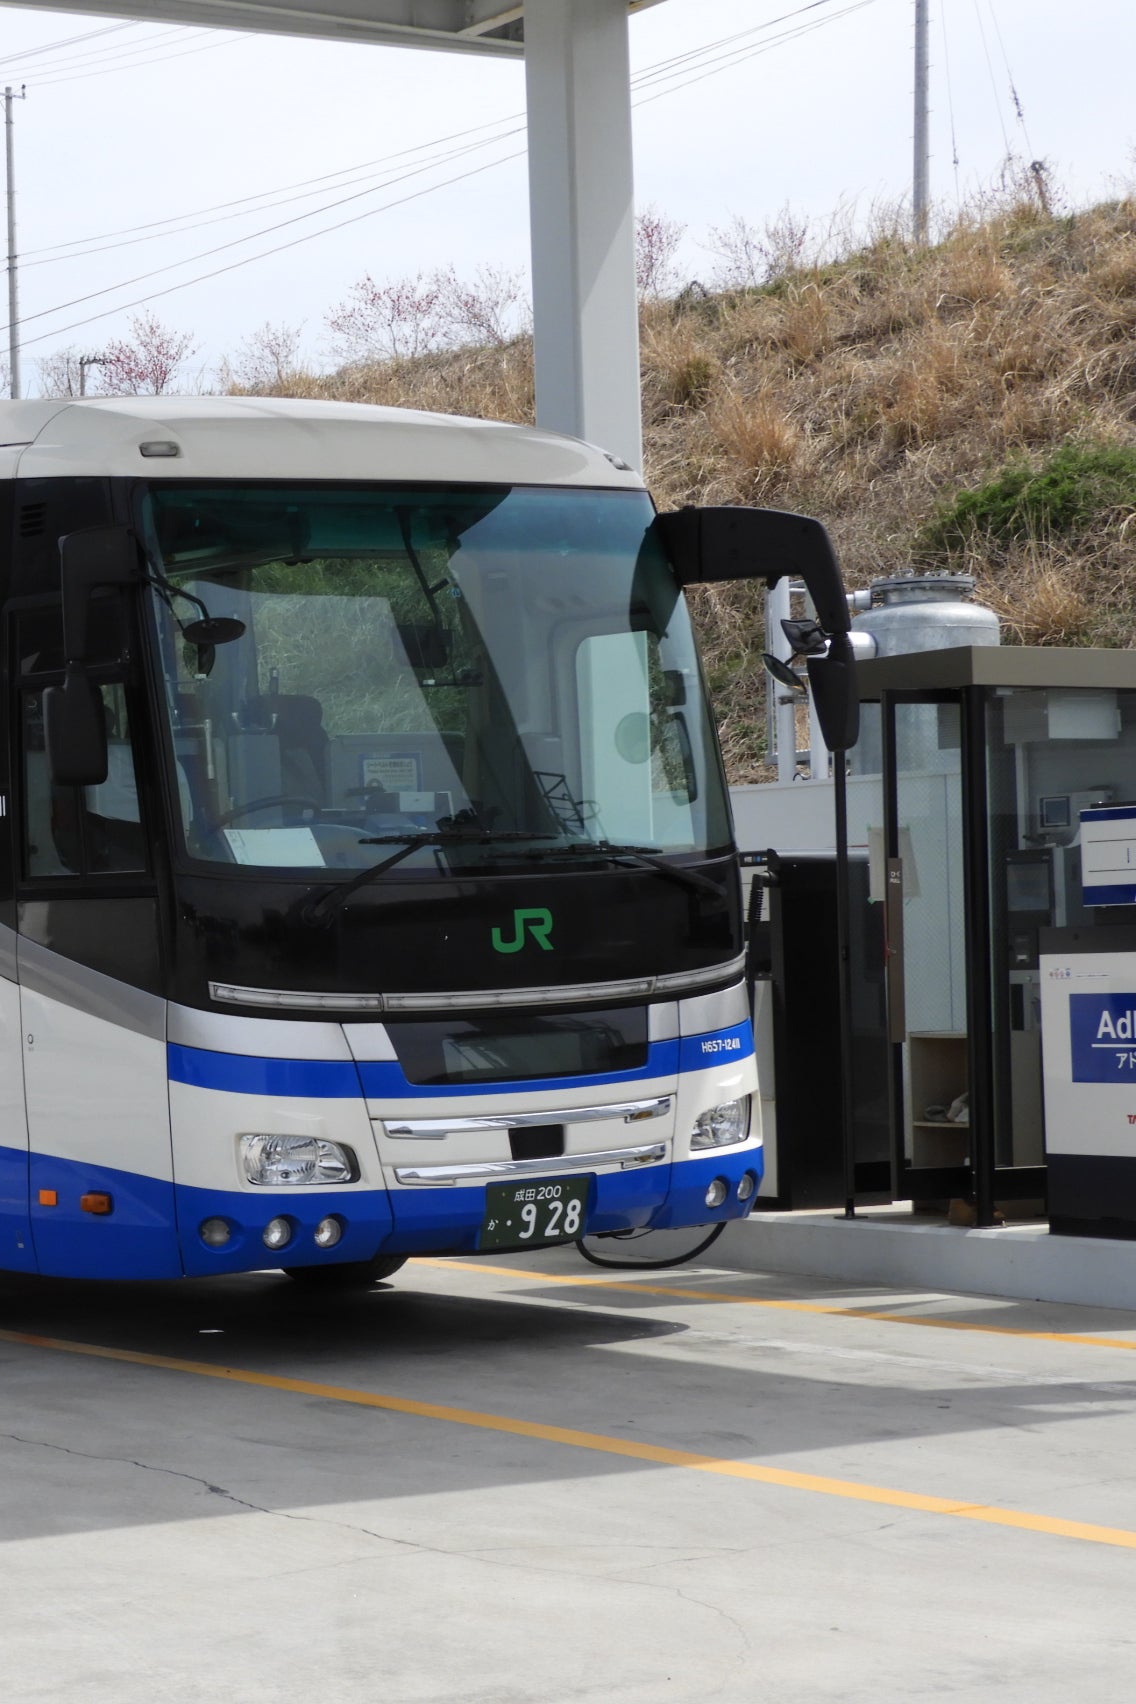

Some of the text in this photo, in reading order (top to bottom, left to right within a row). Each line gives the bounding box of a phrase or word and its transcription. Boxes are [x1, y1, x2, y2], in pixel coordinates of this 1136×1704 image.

[491, 907, 554, 953] JR
[514, 1185, 562, 1202] 成田 200
[487, 1219, 499, 1231] か
